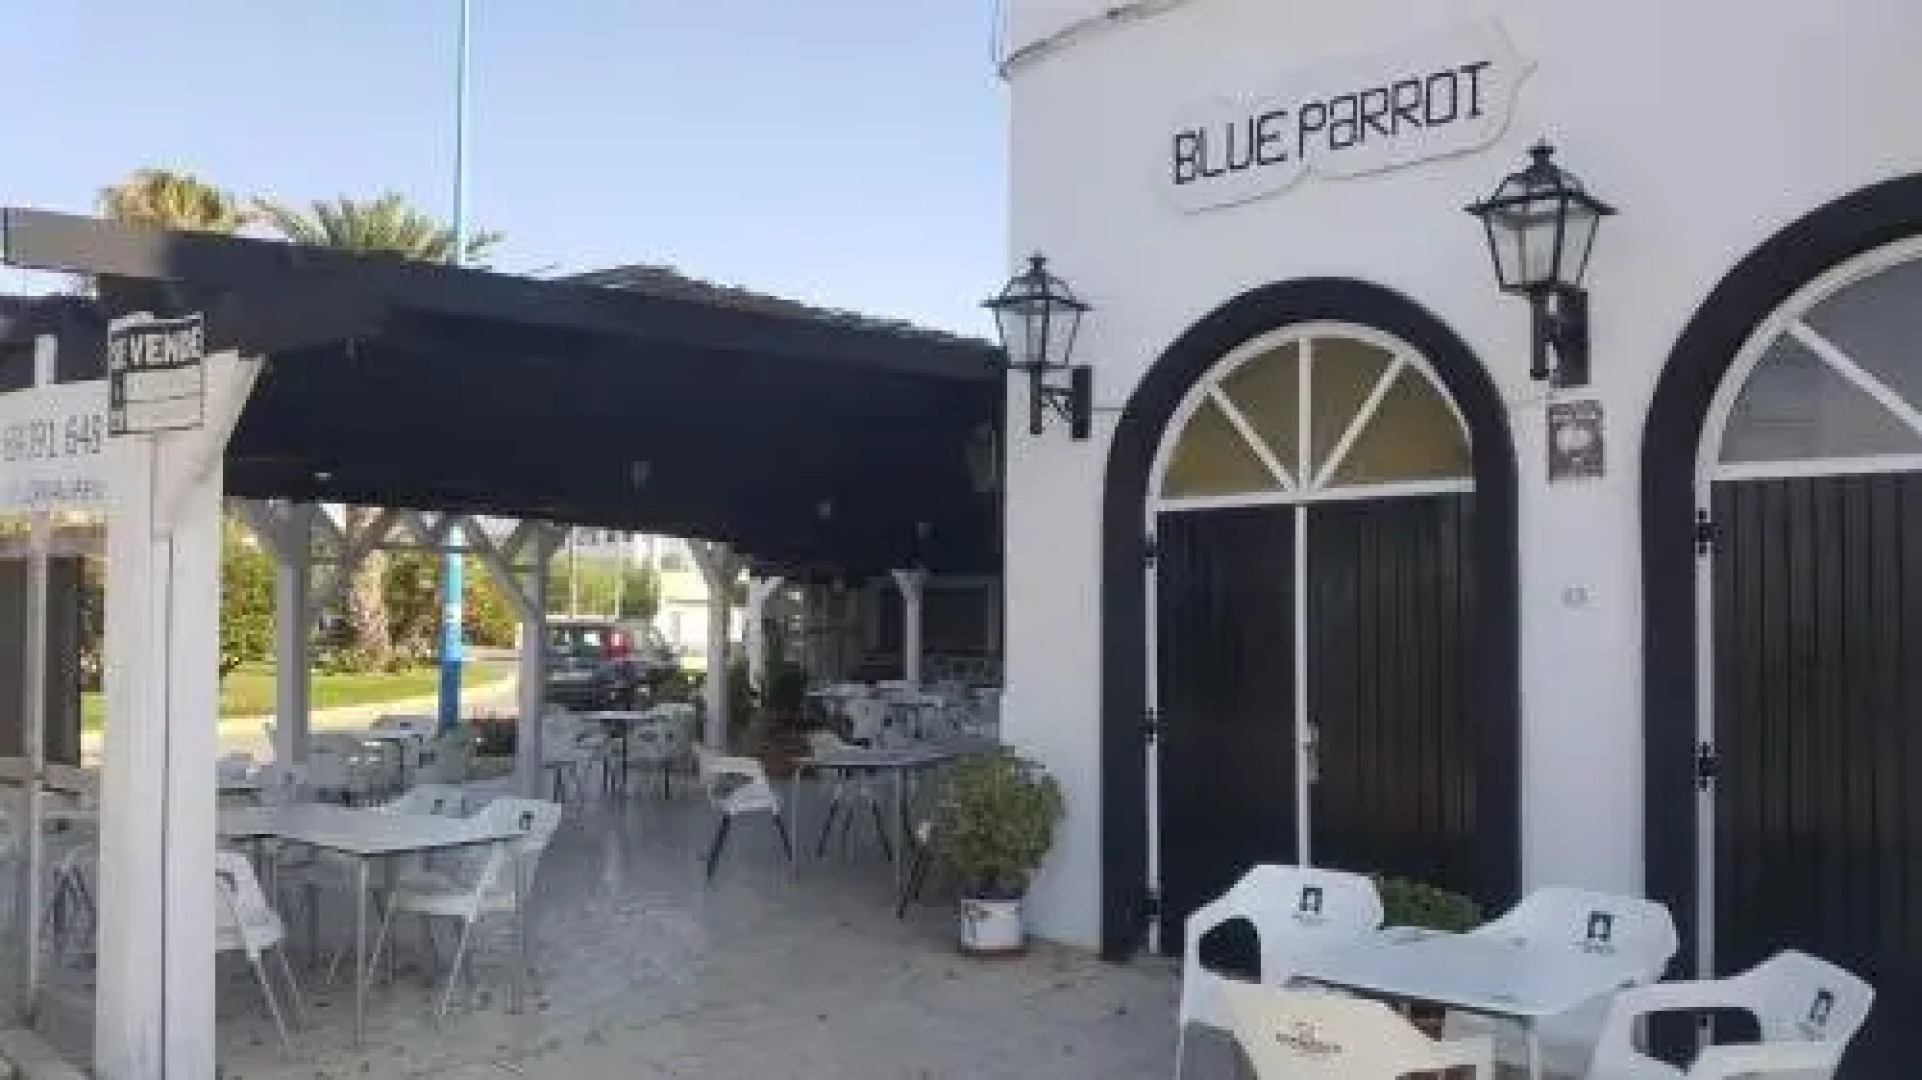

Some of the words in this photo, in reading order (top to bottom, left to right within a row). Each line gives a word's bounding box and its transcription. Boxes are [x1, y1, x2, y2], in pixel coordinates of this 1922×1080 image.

[1173, 109, 1288, 184] BLUE
[1299, 60, 1492, 159] PARROT
[129, 325, 203, 366] VENDE
